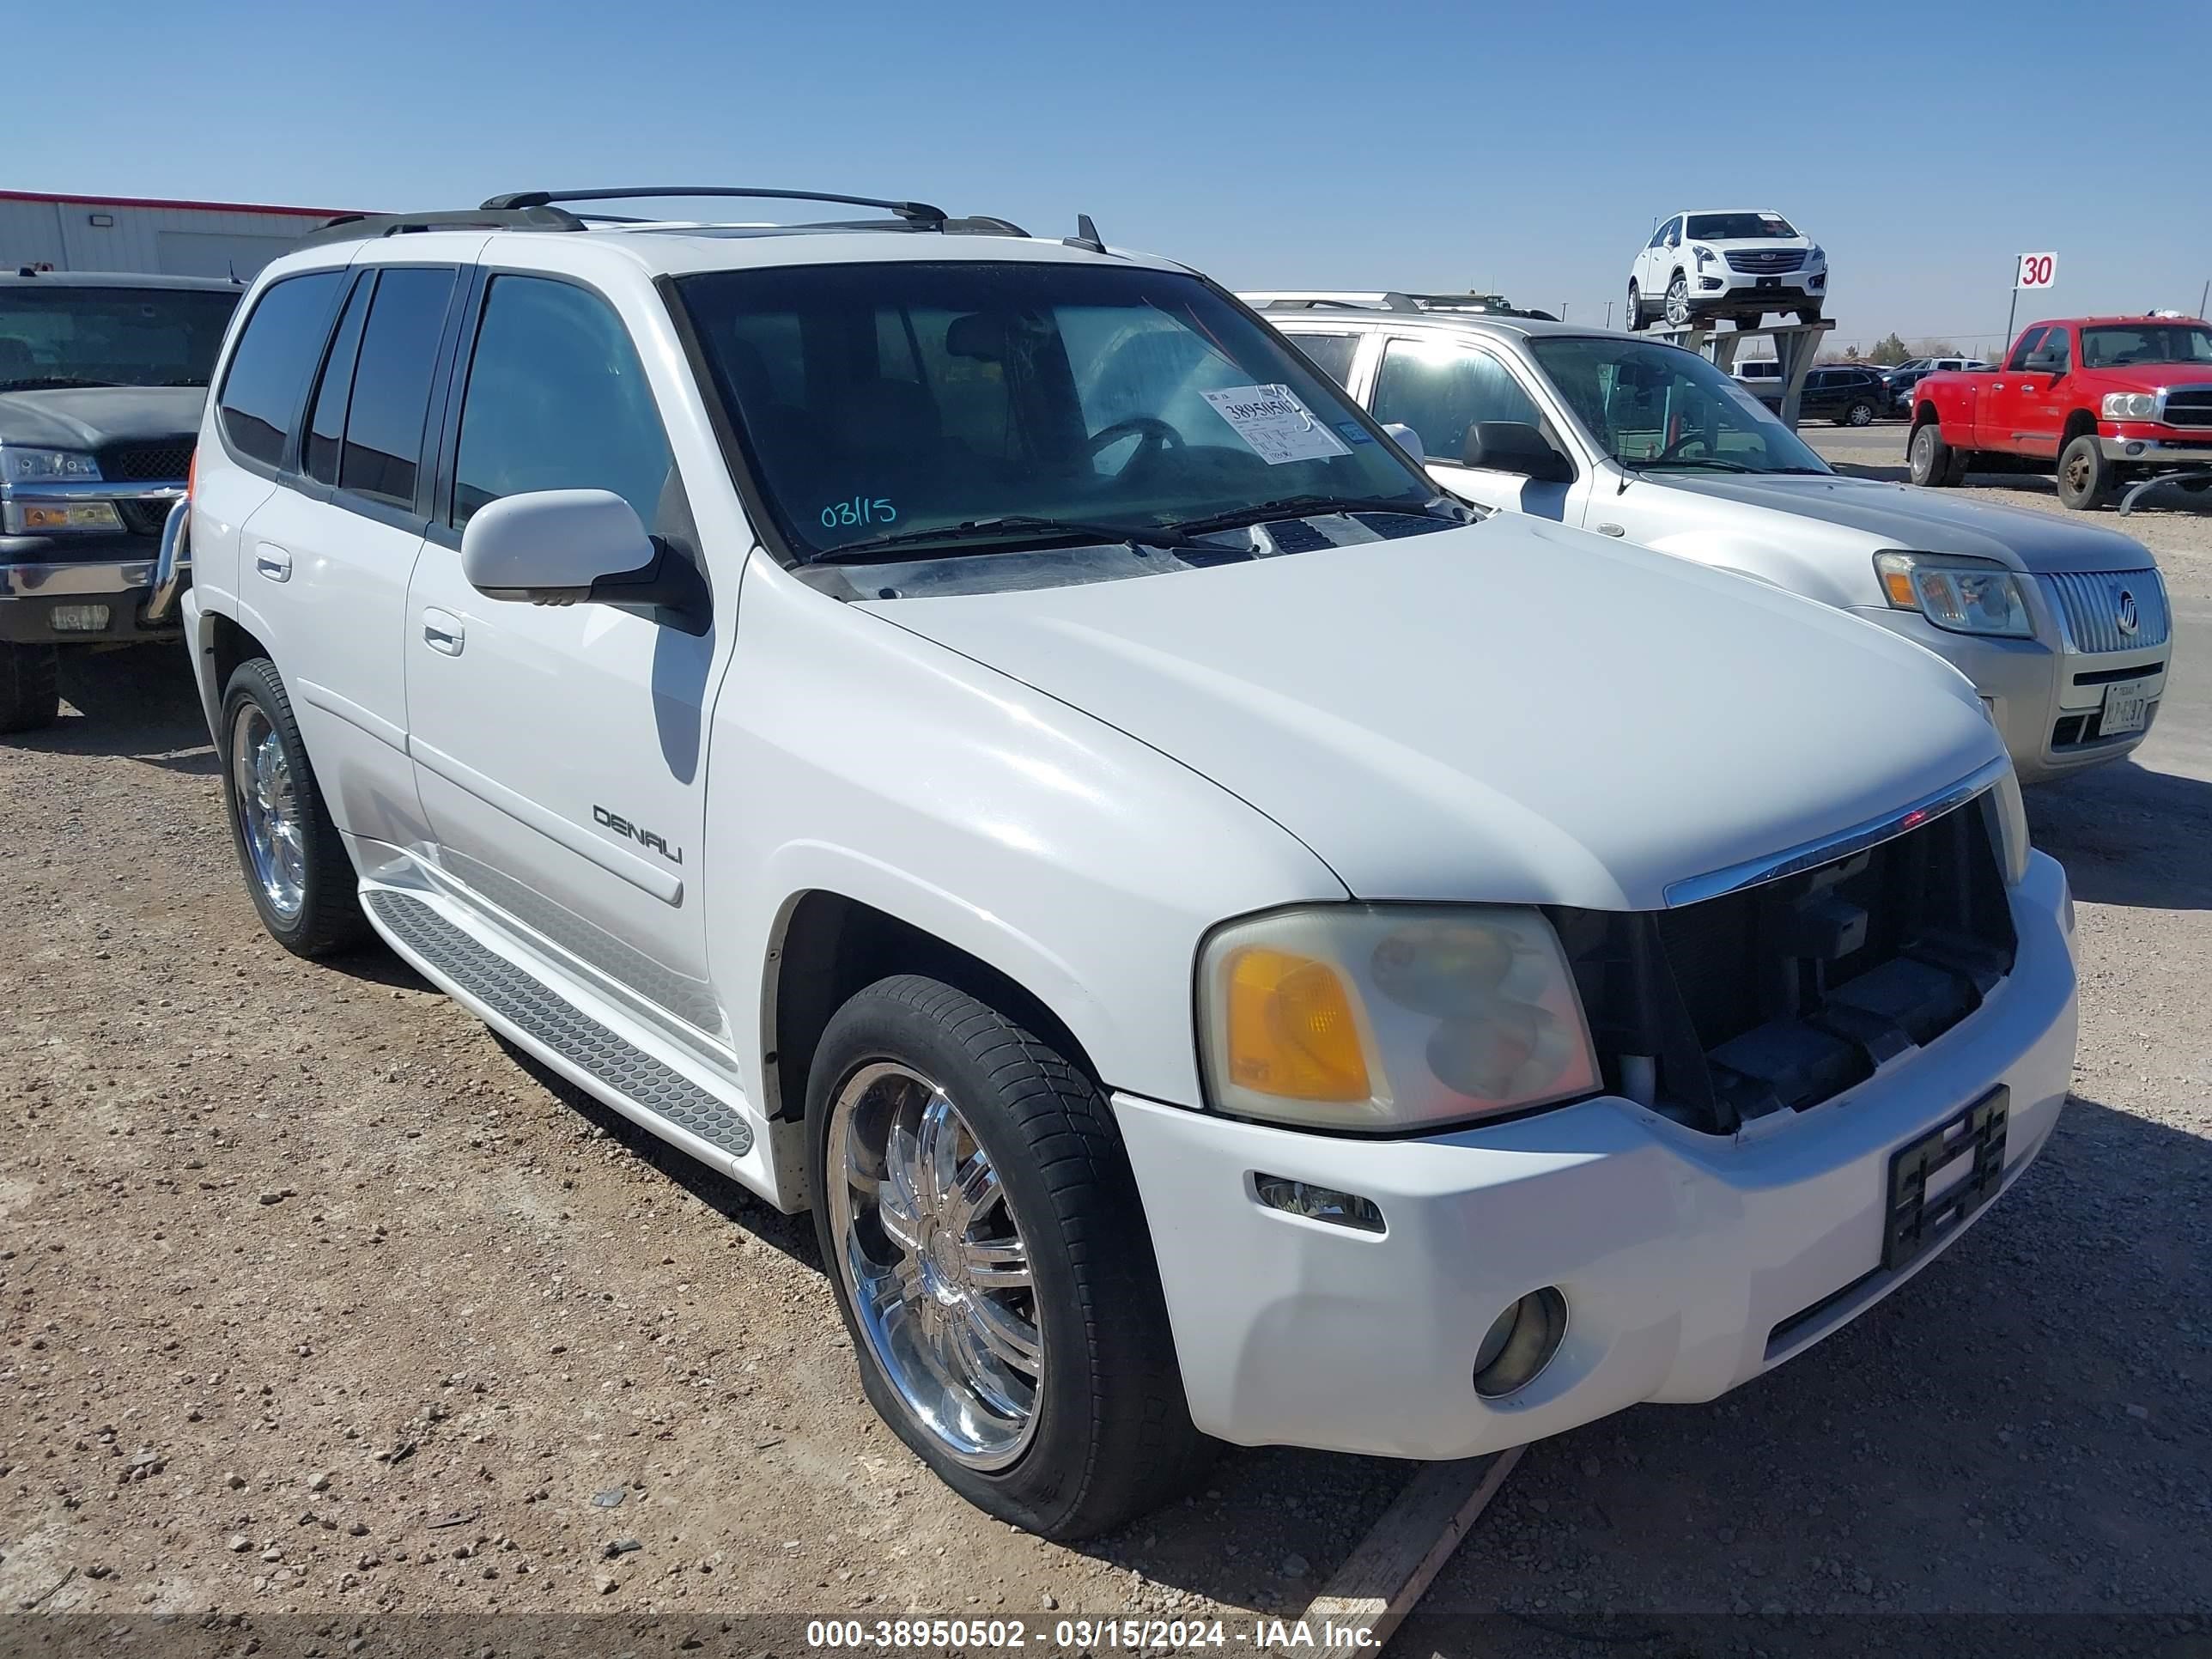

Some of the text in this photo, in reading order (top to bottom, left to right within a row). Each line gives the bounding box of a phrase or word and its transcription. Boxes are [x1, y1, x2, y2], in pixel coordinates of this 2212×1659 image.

[2022, 256, 2052, 285] 30
[821, 496, 896, 528] 03/15
[592, 804, 683, 866] DENALI
